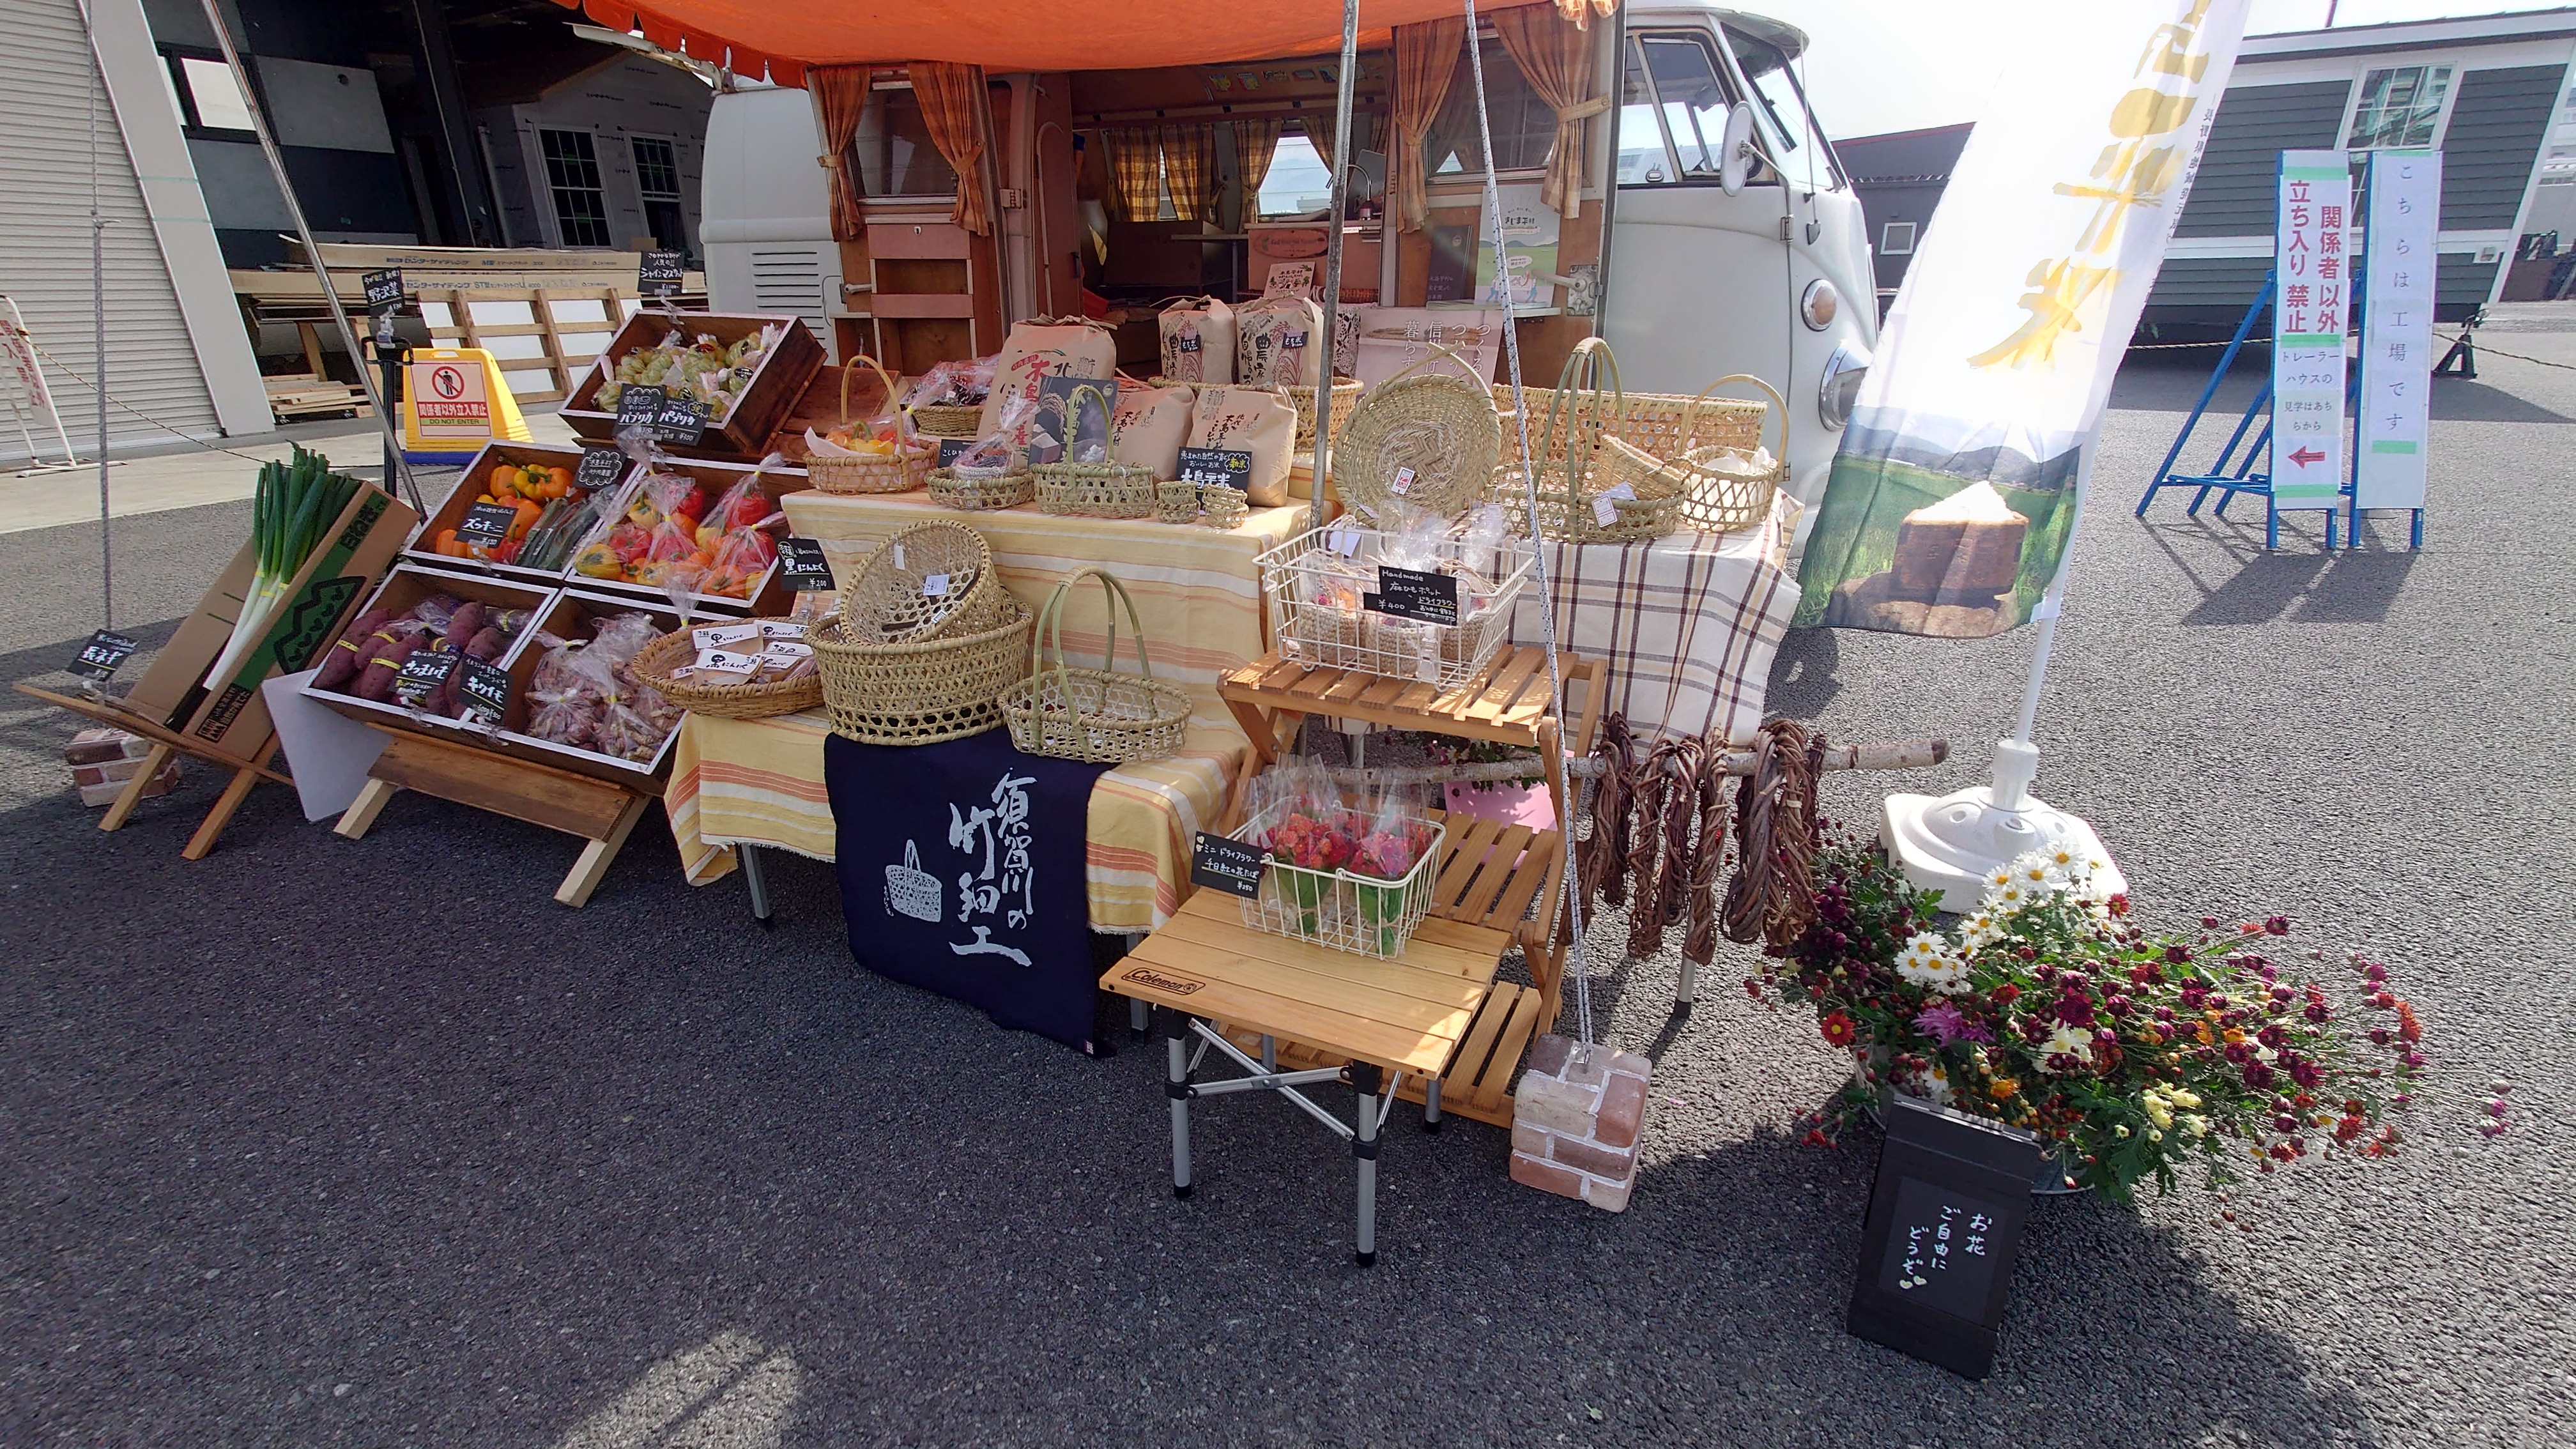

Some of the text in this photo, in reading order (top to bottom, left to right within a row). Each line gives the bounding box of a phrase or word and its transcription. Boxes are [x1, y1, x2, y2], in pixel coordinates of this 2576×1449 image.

[2318, 206, 2342, 334] 関係者以外
[2386, 165, 2413, 431] こちらは工場です
[2282, 352, 2340, 363] トレーラー
[2285, 373, 2333, 385] ハウスの
[418, 403, 487, 417] 関係者以外立入禁止
[2284, 401, 2332, 412] 見学はあち
[619, 411, 654, 424] パプリカ
[658, 410, 696, 426] パプリカ
[2293, 421, 2321, 431] らから
[462, 518, 503, 532] ズッキーニ
[809, 578, 827, 587] ¥200
[1382, 569, 1424, 582] Handmade
[1378, 599, 1406, 610] ¥400
[1418, 596, 1457, 606] ドライフラワー
[82, 646, 124, 664] 長ネギ
[401, 661, 448, 679] さつまいも
[468, 675, 505, 704] キクイモ
[992, 772, 1038, 930] 須賀川の
[1204, 843, 1256, 862] ミニ ドライフラワー
[949, 802, 1032, 967] 竹細工
[1237, 881, 1253, 892] ¥250
[1131, 970, 1184, 990] Coleman
[1931, 1205, 1962, 1270] ご自由に
[1965, 1213, 1993, 1256] お花
[1902, 1225, 1930, 1275] どうぞ
